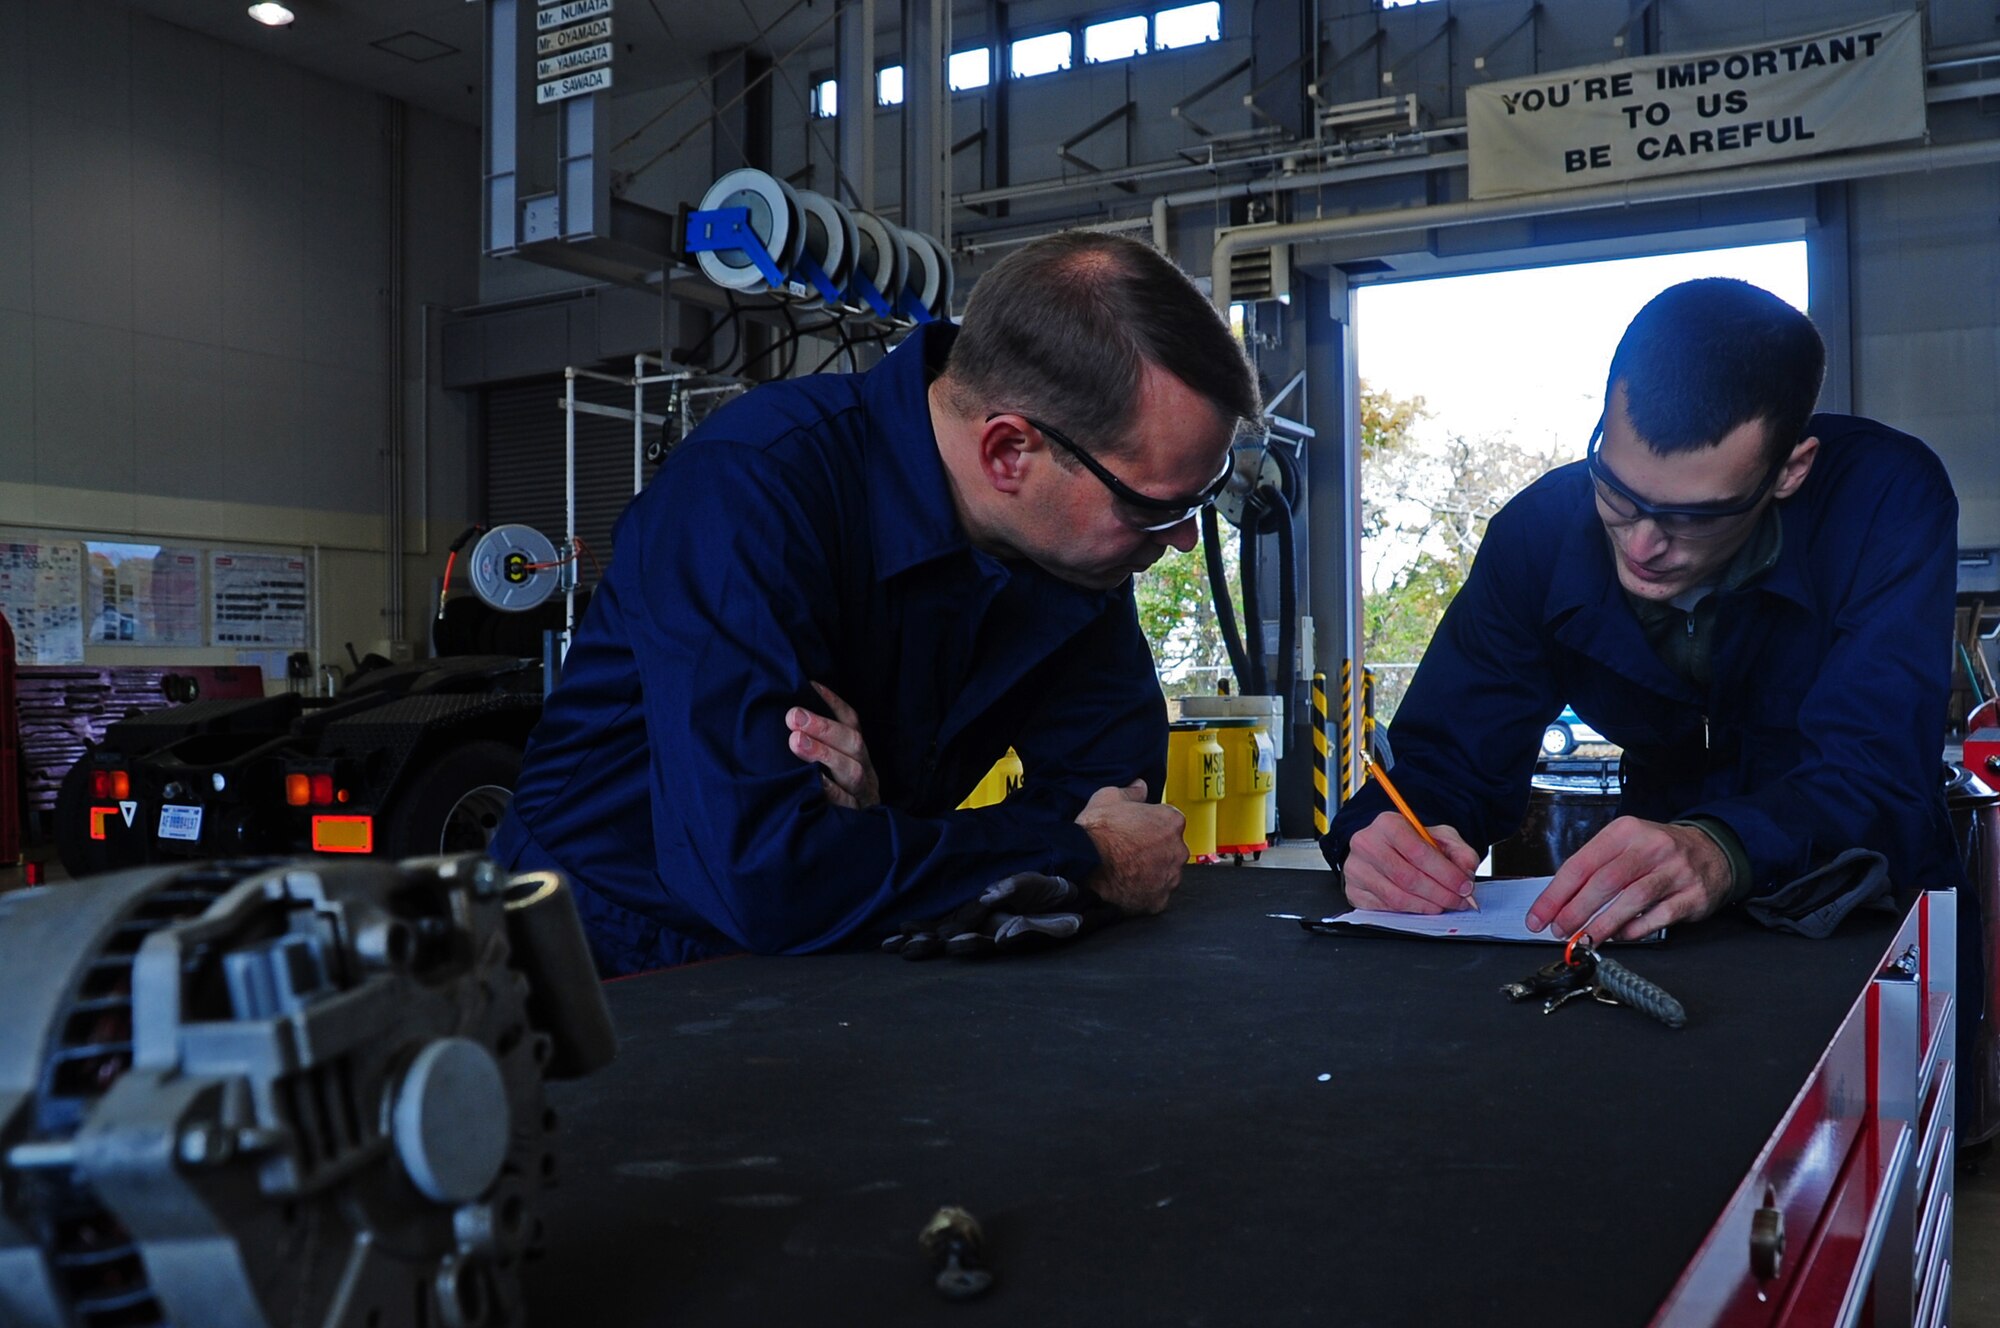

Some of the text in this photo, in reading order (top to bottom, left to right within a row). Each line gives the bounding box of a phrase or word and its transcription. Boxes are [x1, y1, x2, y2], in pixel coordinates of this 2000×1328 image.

[539, 0, 608, 26] Mr. NUMATA
[538, 21, 607, 50] Mr. OYAMADA
[539, 46, 608, 75] Mr. YAMAGATA
[1501, 31, 1883, 116] YOU'RE IMPORTANT
[543, 72, 603, 99] Mr. SAWADA
[1622, 90, 1748, 129] TO US
[1564, 115, 1815, 174] BE CAREFUL
